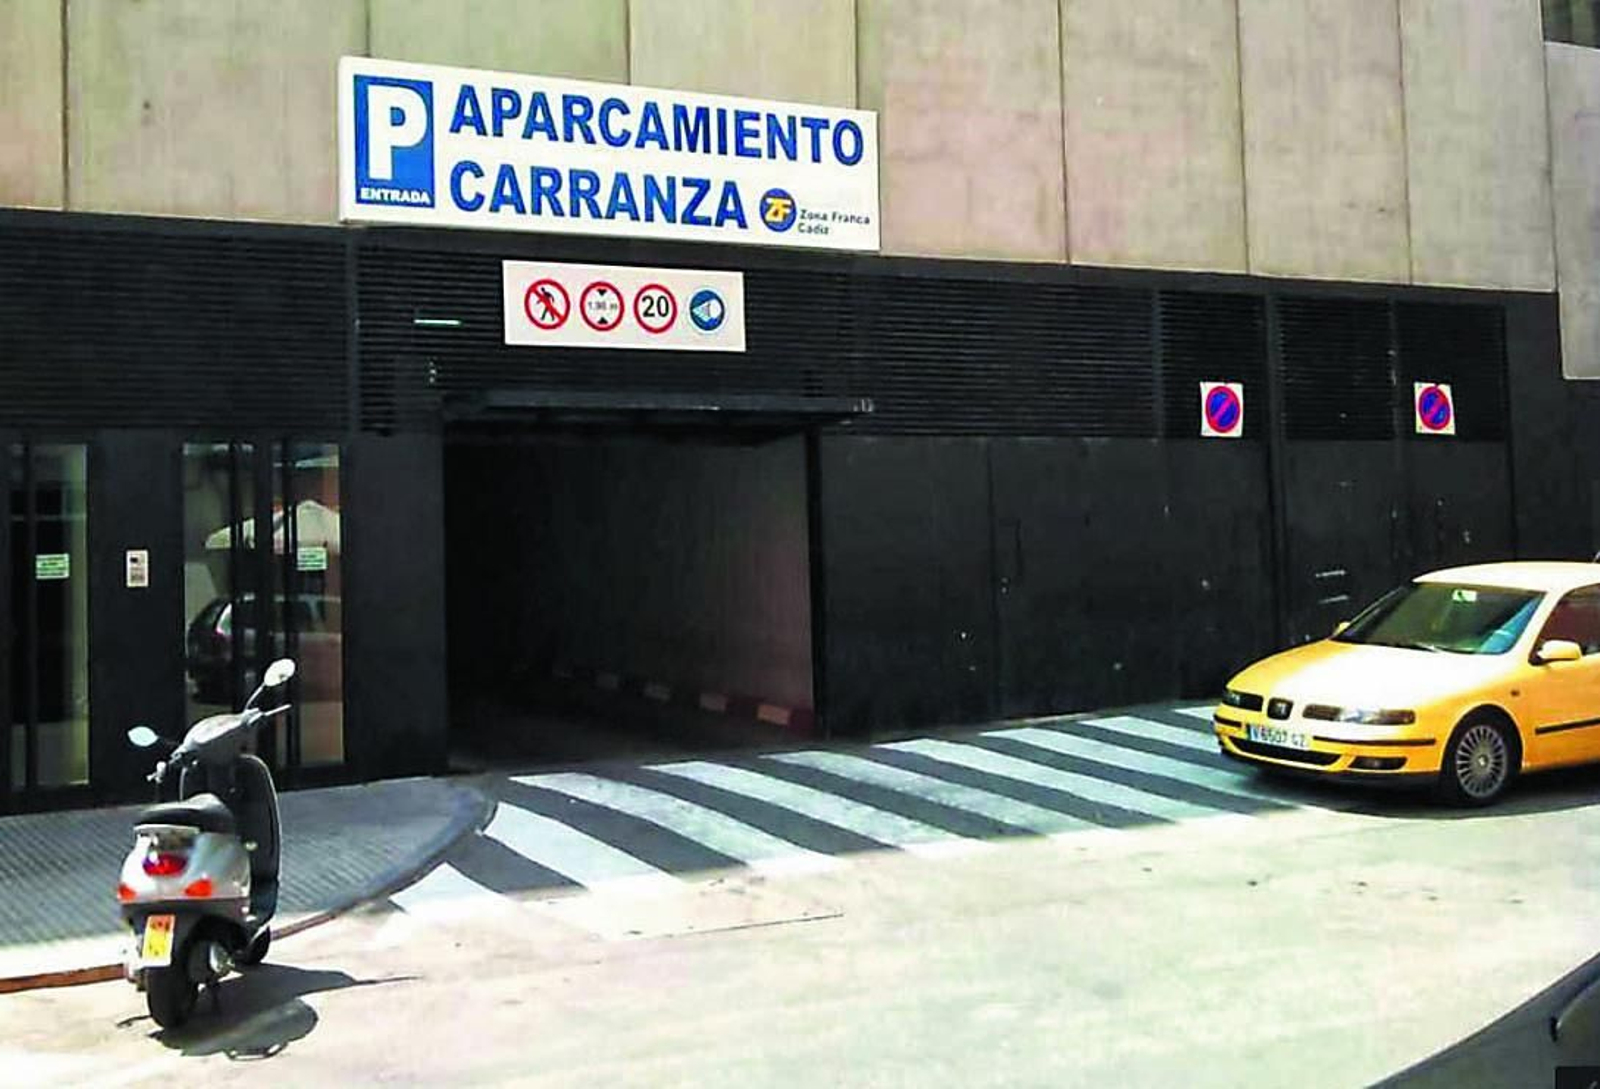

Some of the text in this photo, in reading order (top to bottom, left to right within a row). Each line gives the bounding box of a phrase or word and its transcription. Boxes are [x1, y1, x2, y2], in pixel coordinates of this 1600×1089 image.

[367, 83, 428, 181] P
[449, 84, 864, 167] APARCAMIENTO
[360, 187, 432, 204] ENTRADA
[449, 160, 748, 229] CARRANZA
[800, 208, 870, 224] Zona Franca
[642, 295, 670, 318] 20
